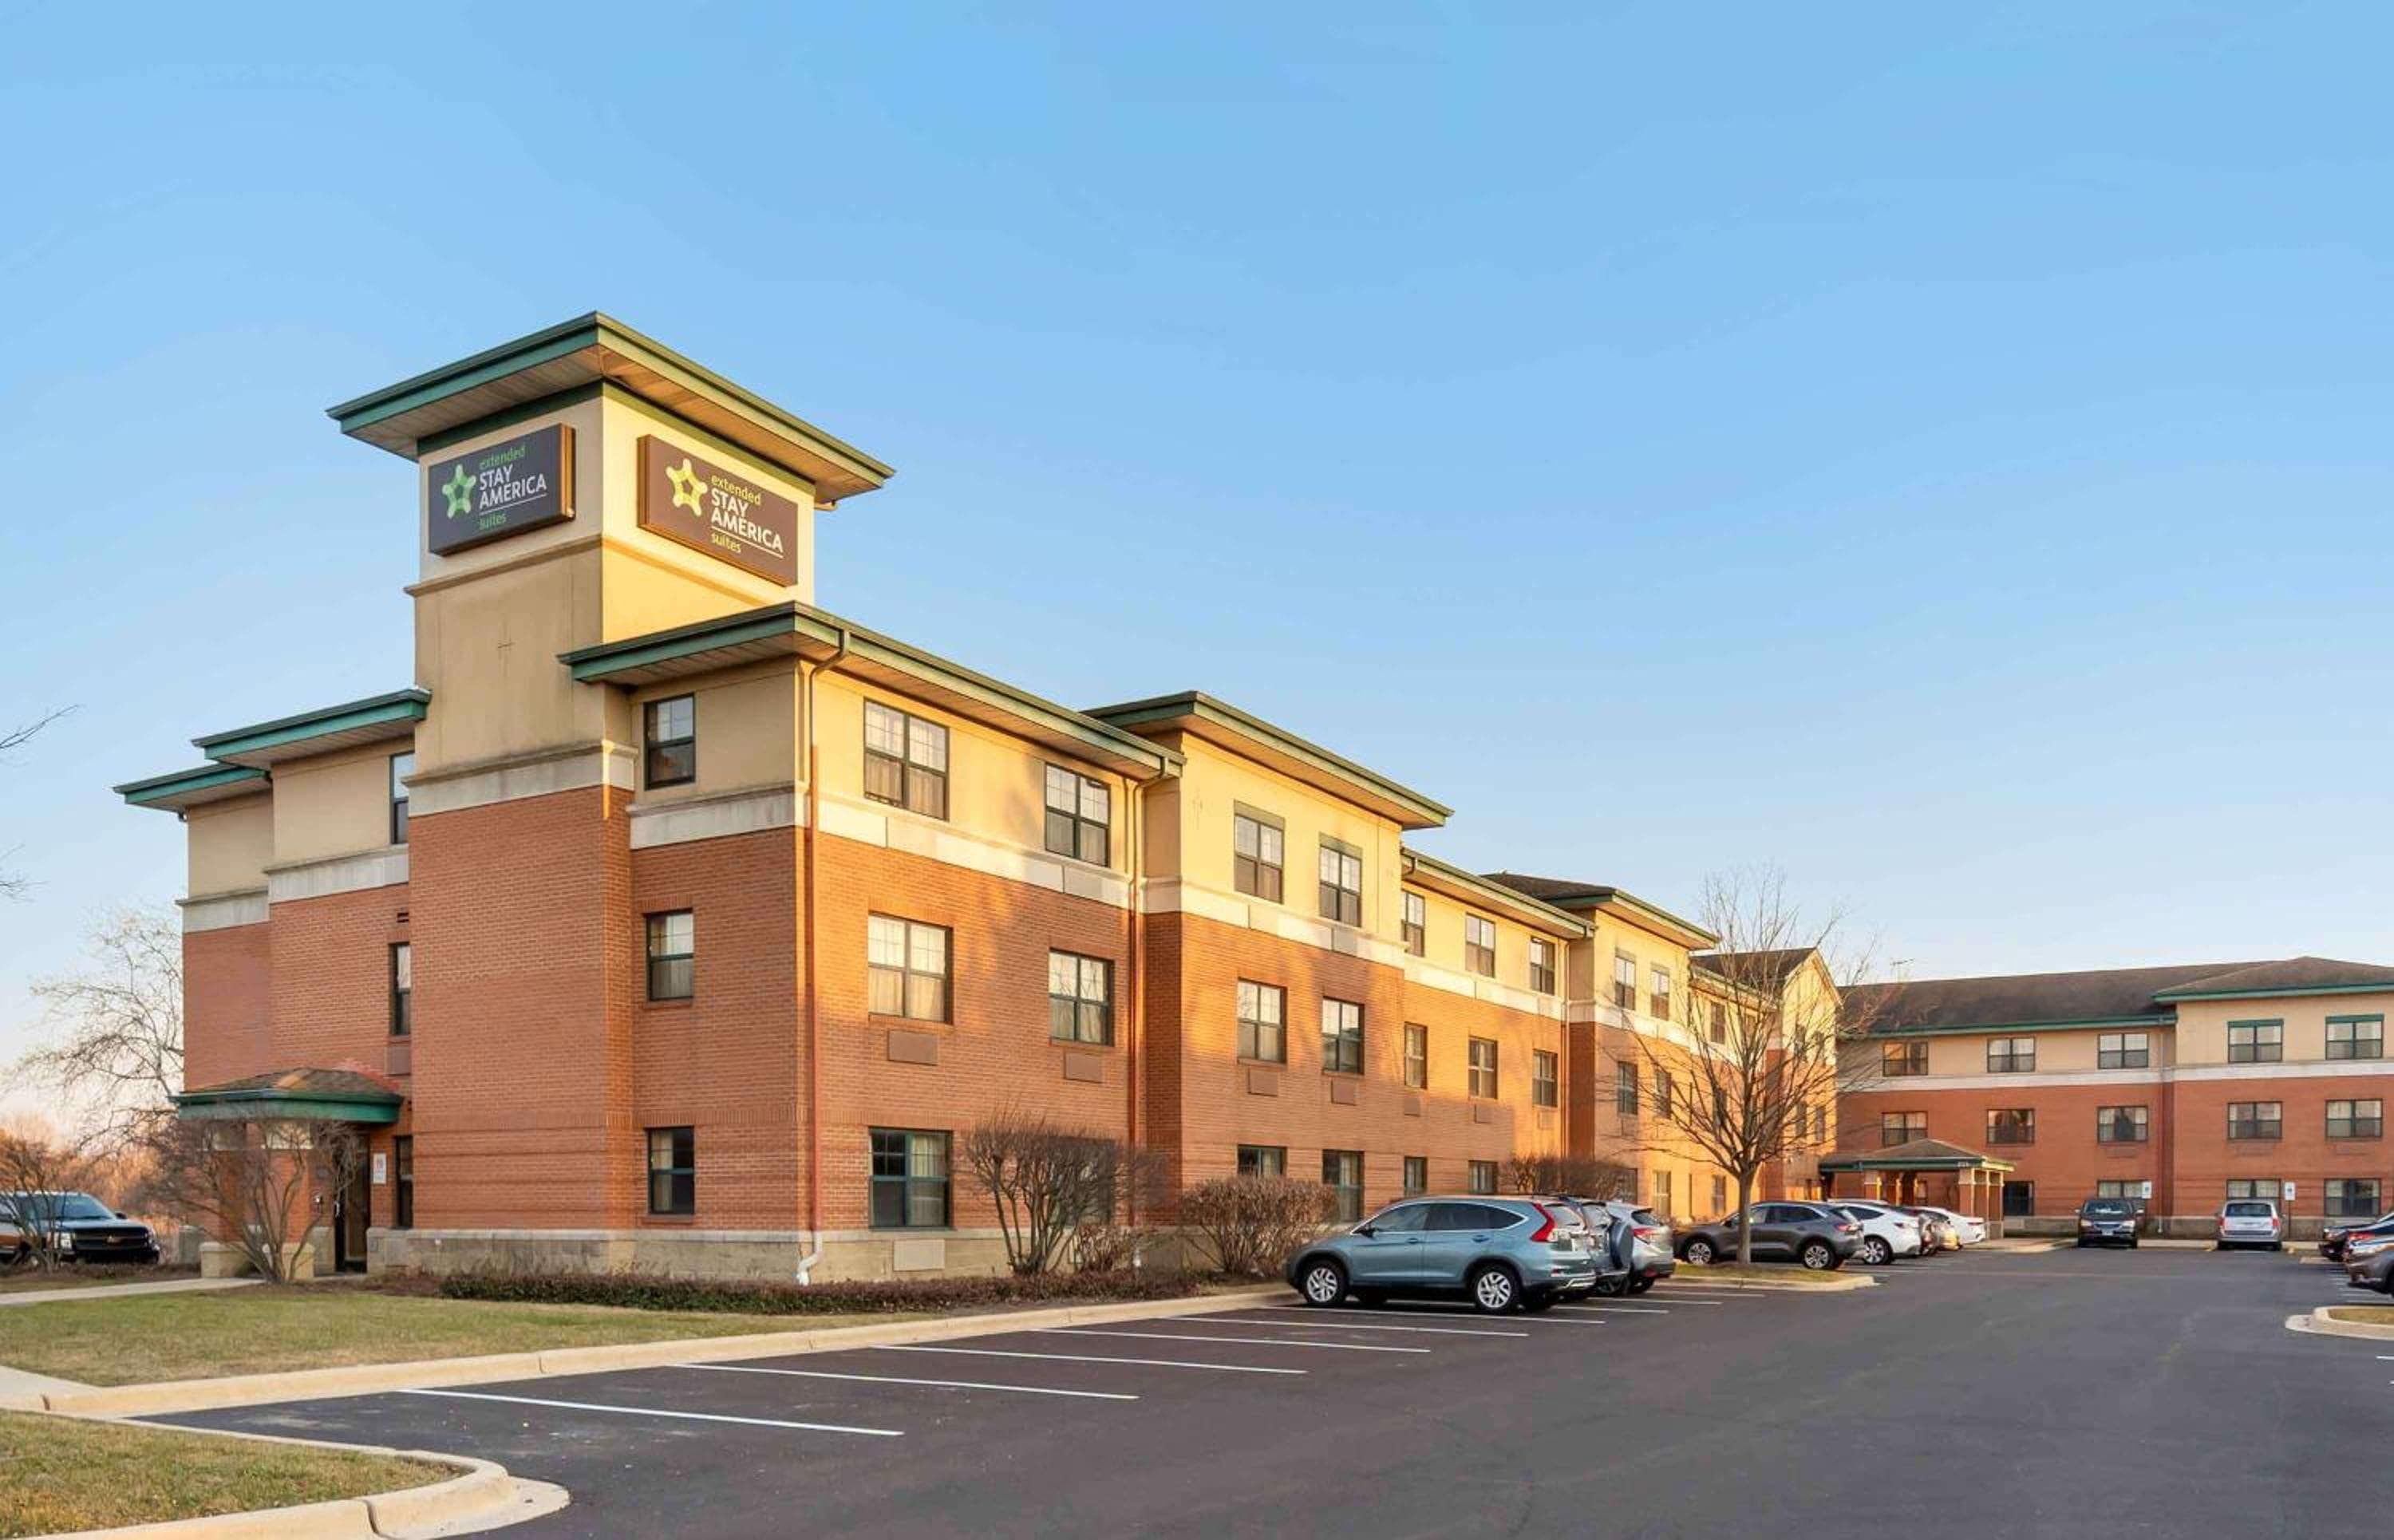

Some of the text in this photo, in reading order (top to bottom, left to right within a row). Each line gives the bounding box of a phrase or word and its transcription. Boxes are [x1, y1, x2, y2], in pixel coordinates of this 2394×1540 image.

[480, 445, 526, 468] extended
[480, 464, 513, 491] STAY
[480, 473, 547, 509] AMERICA
[711, 475, 760, 505] extended
[711, 488, 749, 516] STAY
[480, 512, 507, 530] suites
[711, 507, 784, 553] AMERICA
[711, 532, 741, 553] suites
